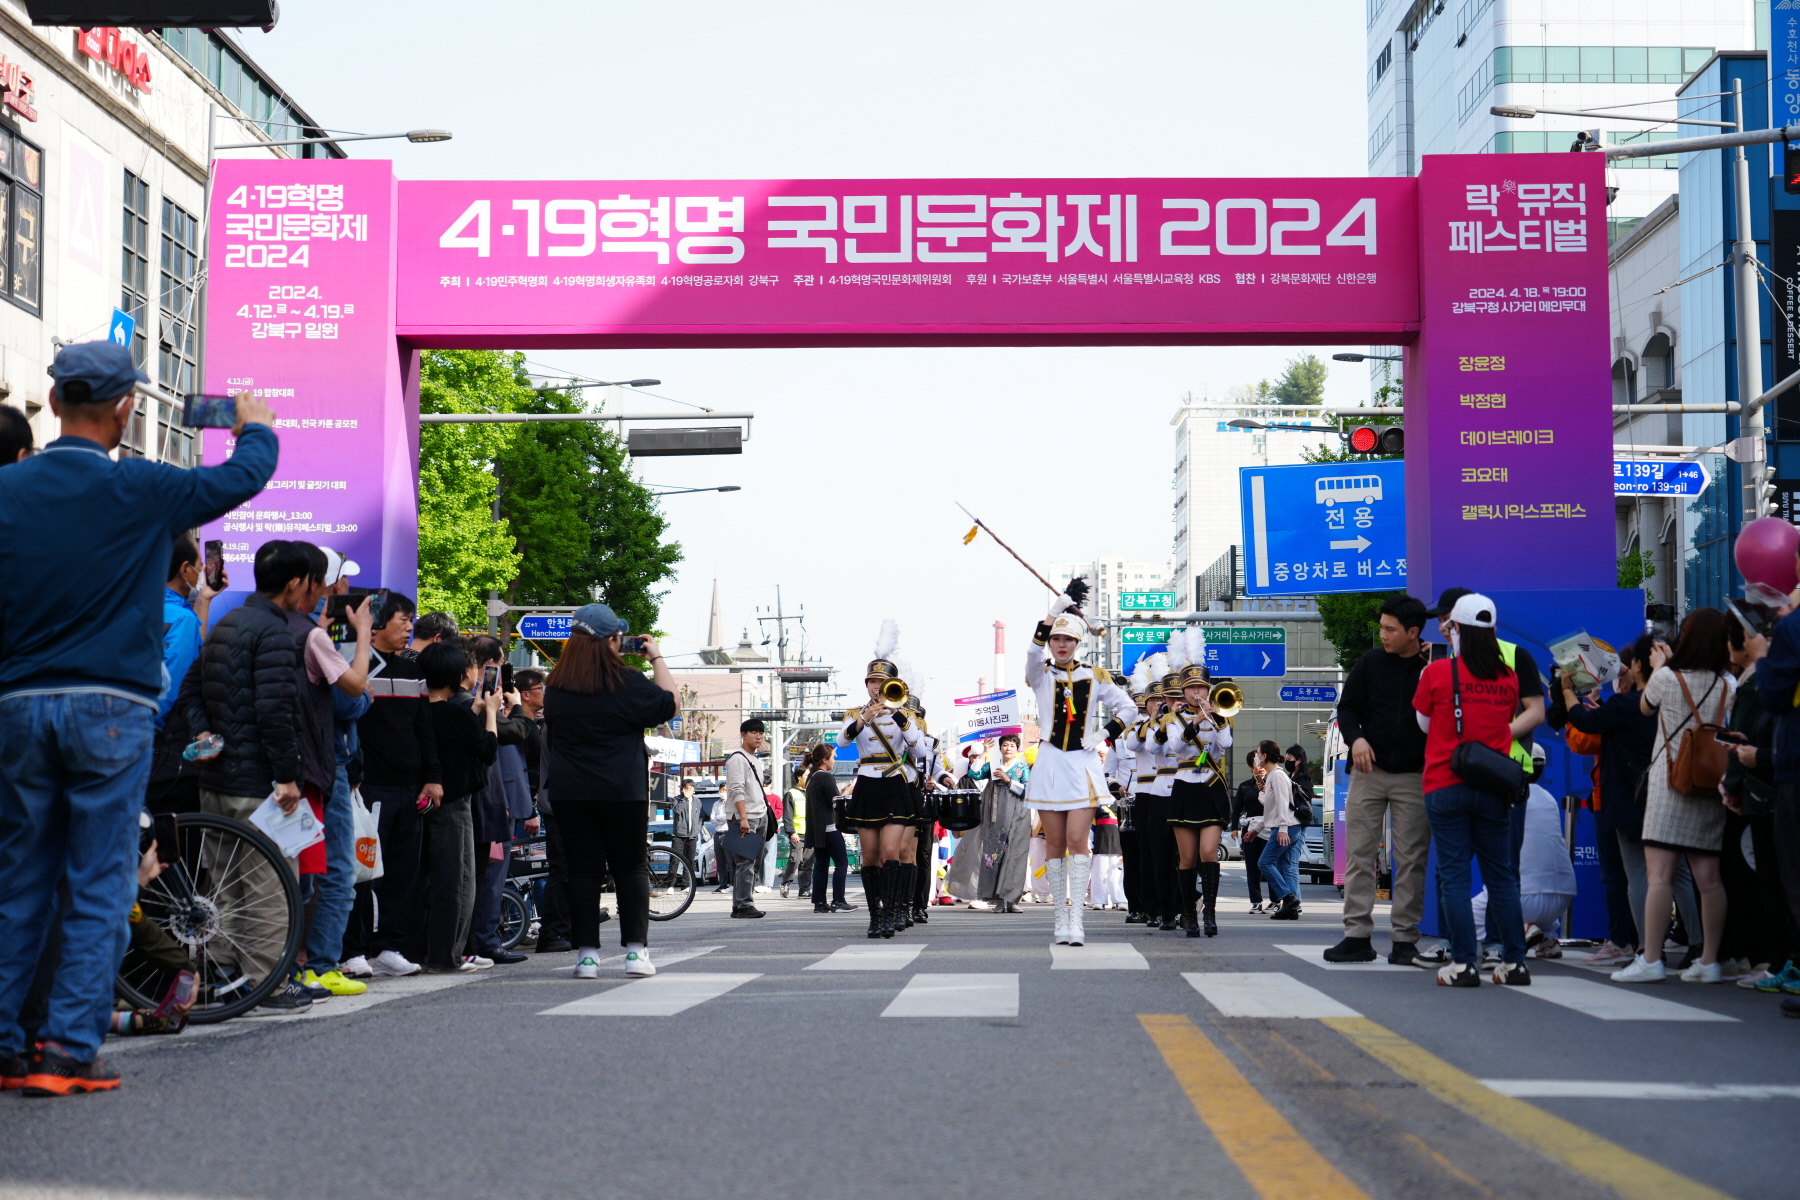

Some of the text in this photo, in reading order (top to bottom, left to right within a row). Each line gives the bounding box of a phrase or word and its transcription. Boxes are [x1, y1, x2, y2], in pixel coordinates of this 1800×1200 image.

[1787, 17, 1798, 64] 수호천사
[226, 213, 368, 242] 국민문화제
[768, 192, 1137, 264] 국민문화제
[1160, 198, 1377, 256] 2024
[1449, 220, 1587, 253] 페스티벌
[225, 245, 309, 268] 2024
[440, 276, 461, 287] 주최
[749, 275, 779, 286] 강북구
[793, 275, 814, 286] 주관
[966, 274, 987, 285] 후원
[1002, 274, 1053, 285] 국가보훈부
[1058, 274, 1108, 285] 서울특별시
[1113, 273, 1194, 285] 서울특별시교육청
[1199, 274, 1221, 284] KBS
[1235, 273, 1256, 285] 협찬
[1270, 273, 1331, 285] 강북문화재단
[1336, 273, 1377, 285] 신한은행
[269, 286, 322, 299] 2024.
[1552, 287, 1586, 297] 19:00
[1452, 301, 1586, 313] 강북구청 사거리 메인무대
[251, 323, 338, 339] 강북구 일원
[1459, 356, 1505, 371] 장윤정
[226, 377, 253, 386] 4.12.(금)
[264, 388, 294, 398] 합창대회
[1460, 393, 1506, 408] 박정현
[302, 419, 317, 428] 전국
[318, 419, 333, 428] 카툰
[335, 419, 358, 428] 공모전
[1460, 430, 1554, 445] 데이브레이크
[1461, 468, 1508, 482] 코요태
[298, 481, 305, 490] 및
[307, 481, 329, 490] 글짓기
[331, 481, 346, 490] 대회
[1652, 482, 1687, 493] 139-gil
[224, 511, 254, 520] 시민참여
[1462, 504, 1586, 520] 갤럭시익스프레스
[223, 523, 253, 532] 공식행사
[256, 523, 263, 532] 및
[222, 543, 249, 551] 4.19.(금)
[1274, 561, 1348, 581] 중앙차로
[1124, 594, 1172, 607] 강북구청
[1135, 631, 1165, 642] 쌍문역
[1202, 631, 1229, 640] 사거리
[1232, 631, 1272, 641] 수유사거리
[975, 705, 1000, 716] 추억의
[968, 714, 1009, 728] 이동사진관
[1574, 846, 1599, 859] 국민
